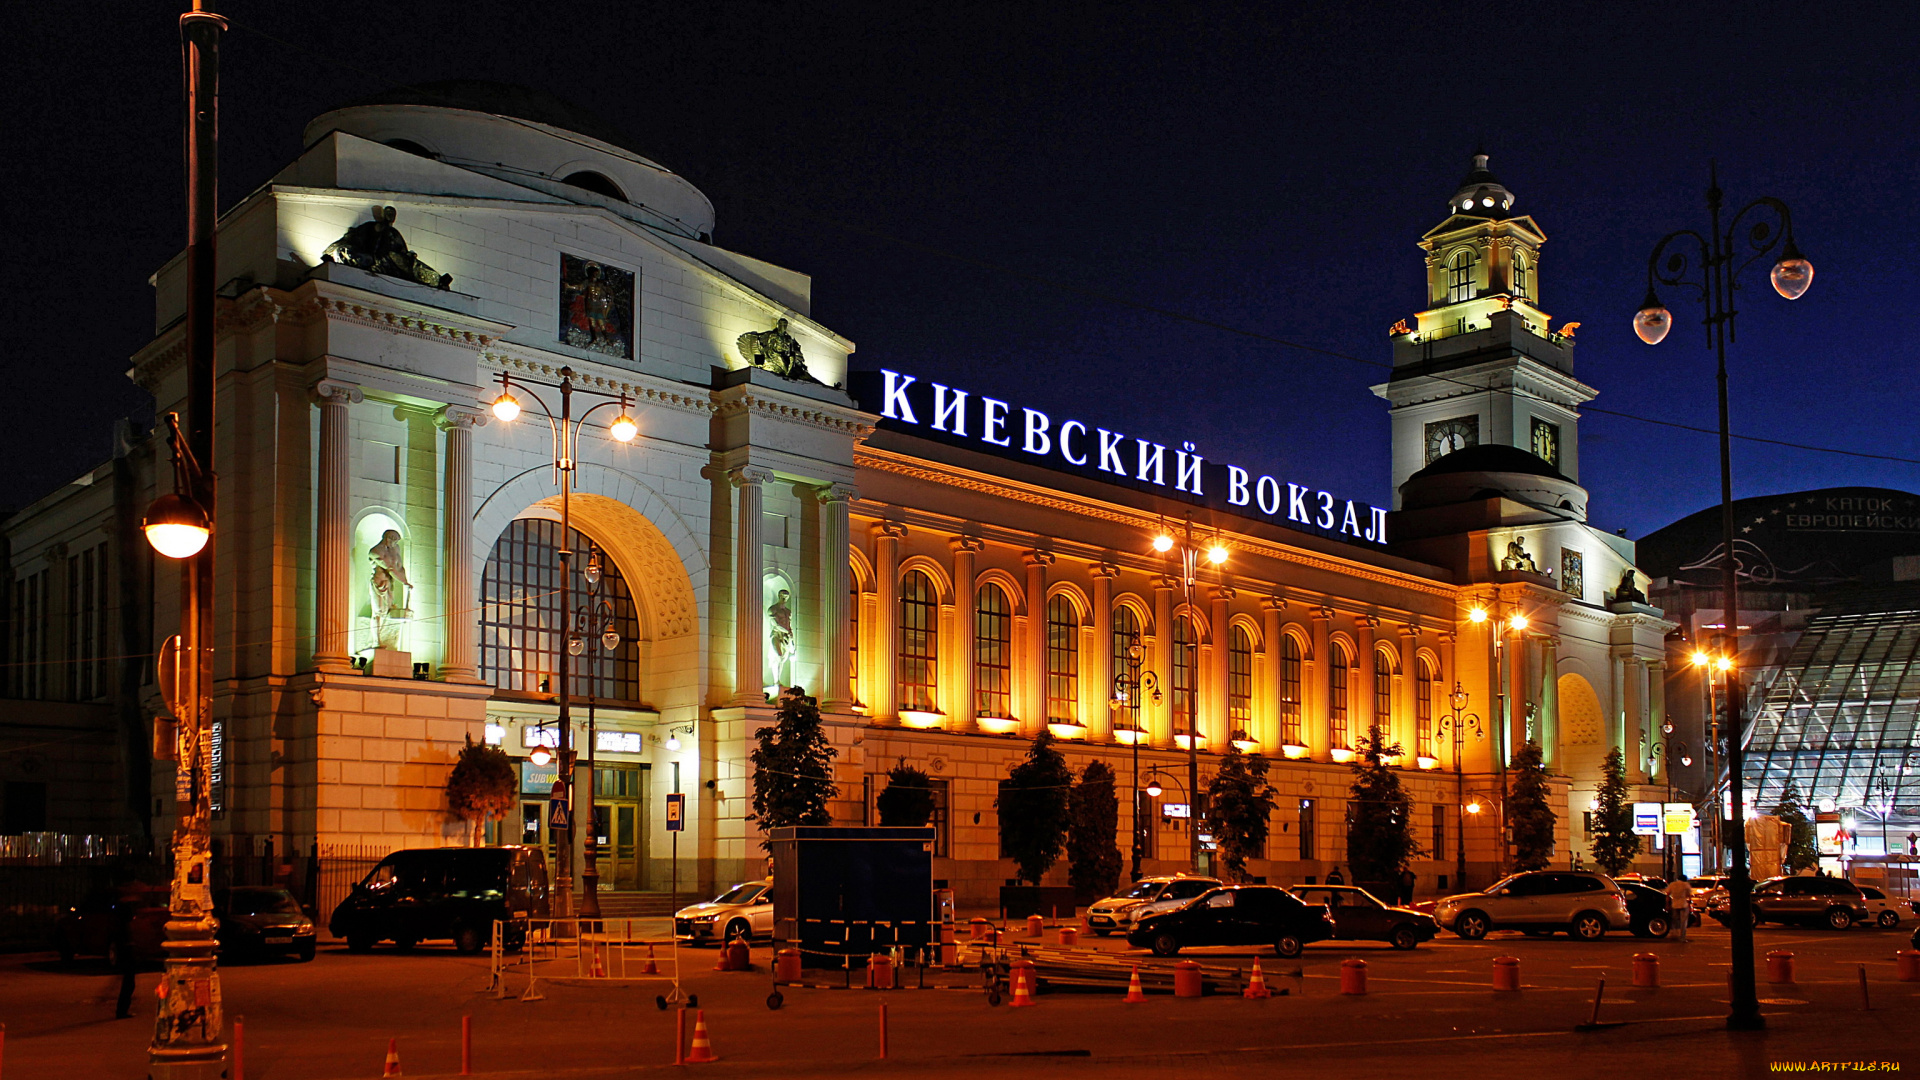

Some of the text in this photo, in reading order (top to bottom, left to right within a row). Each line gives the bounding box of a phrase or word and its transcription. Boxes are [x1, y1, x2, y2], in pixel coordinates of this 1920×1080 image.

[879, 368, 1389, 545] КИЕВСКИЙ ВОКЗАЛ
[1826, 497, 1893, 511] КАТОК
[527, 773, 559, 784] SUBWA
